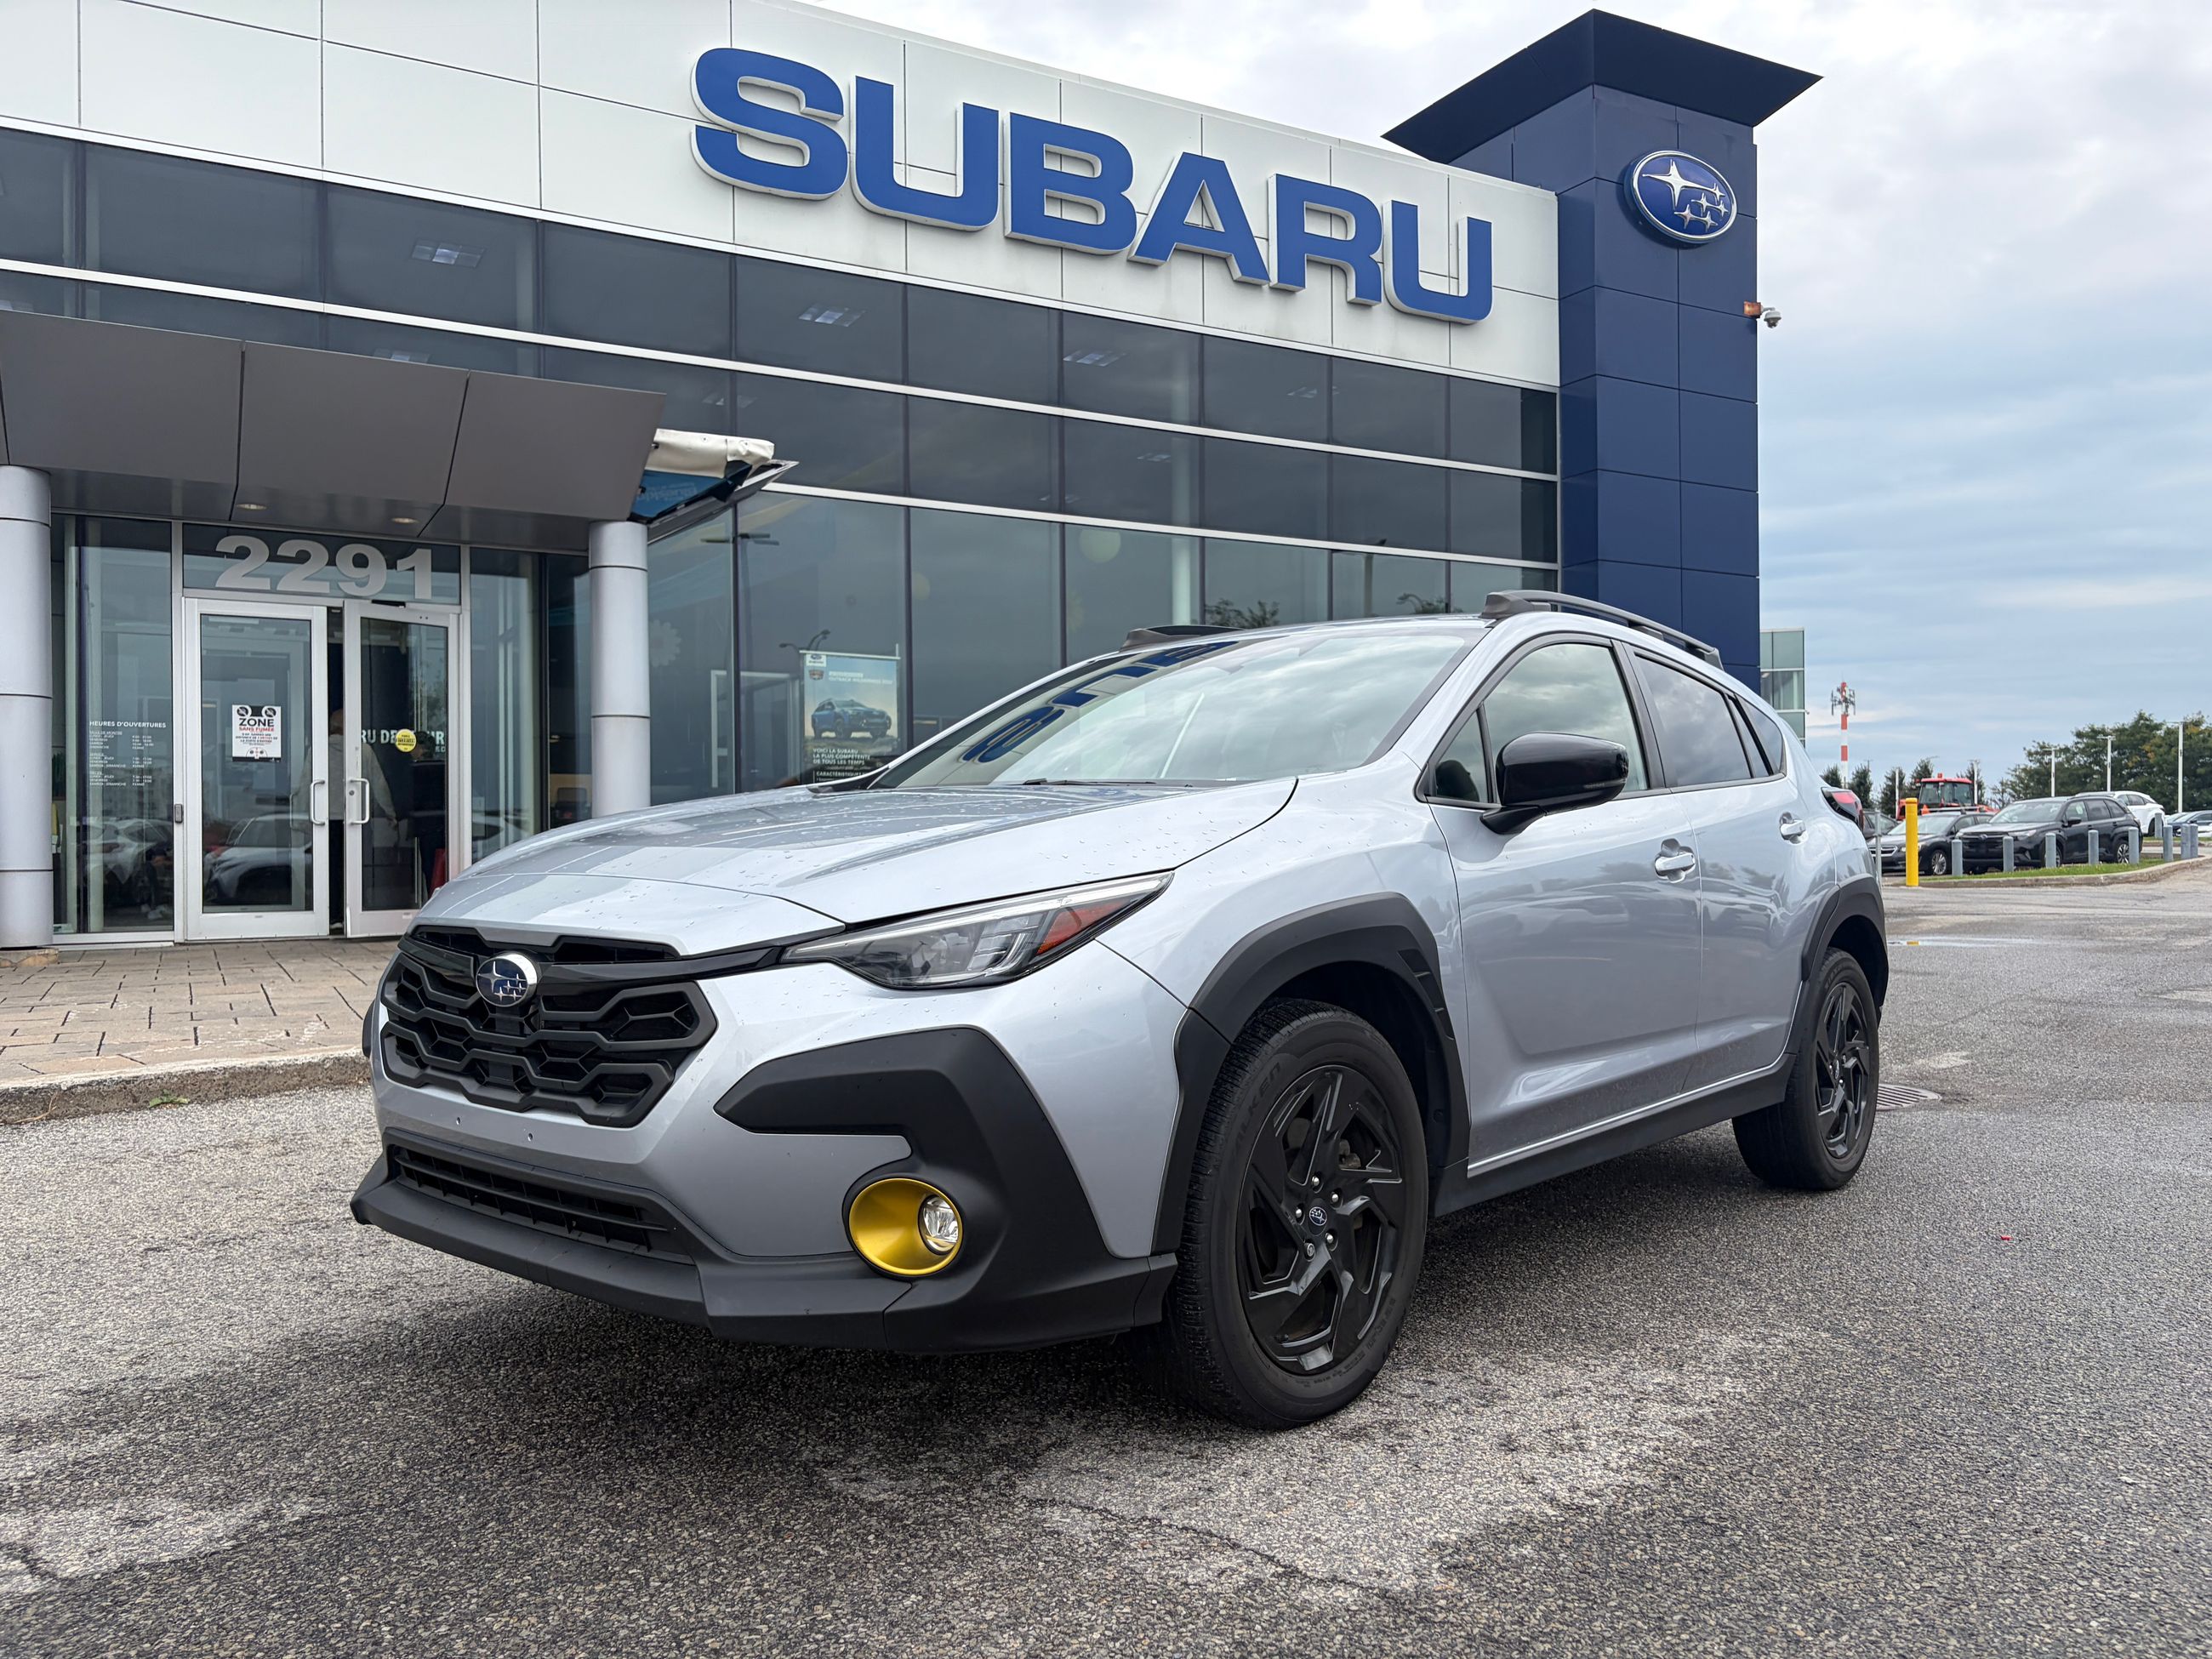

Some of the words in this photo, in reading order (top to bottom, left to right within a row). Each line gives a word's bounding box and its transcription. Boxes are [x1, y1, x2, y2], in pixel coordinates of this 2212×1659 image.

[691, 48, 1494, 325] SUBARU
[215, 535, 432, 600] 2291
[239, 718, 275, 727] ZONE
